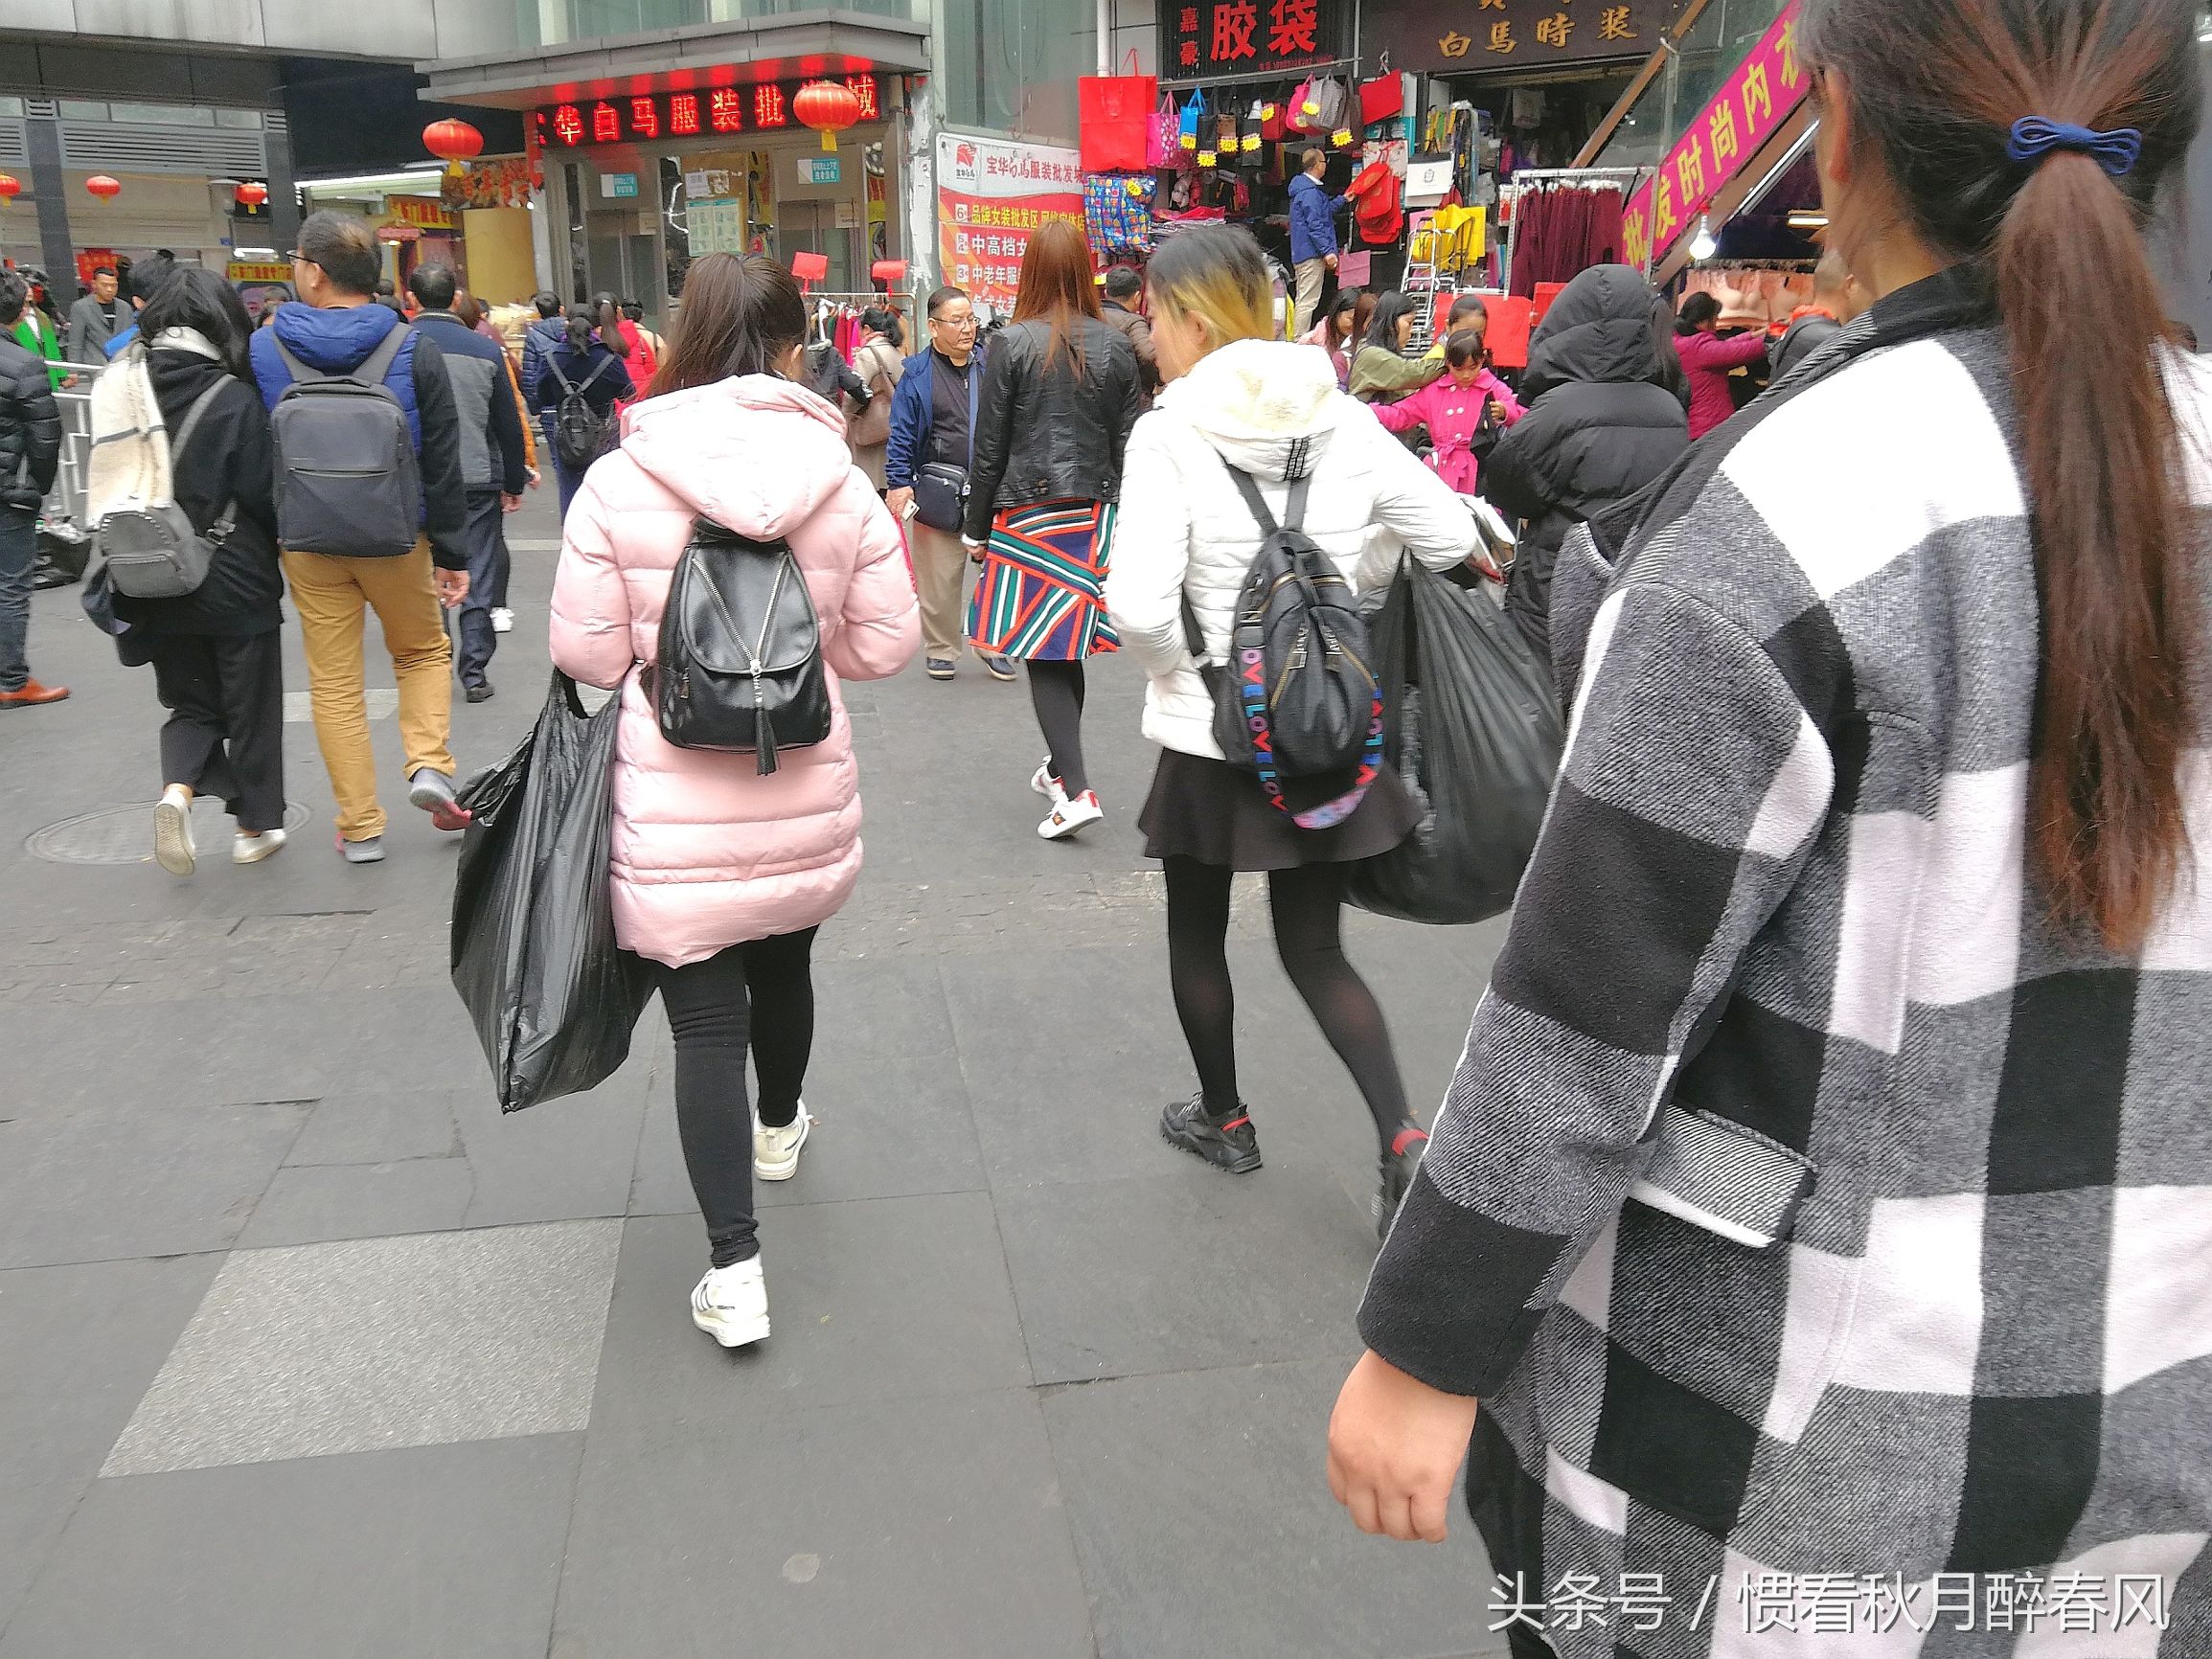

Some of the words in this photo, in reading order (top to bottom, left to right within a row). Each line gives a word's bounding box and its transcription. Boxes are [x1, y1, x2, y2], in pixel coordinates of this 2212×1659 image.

[1179, 7, 1198, 66] 嘉豪
[1210, 0, 1318, 61] 胶袋
[537, 74, 879, 147] 华白马服装批城
[972, 265, 1021, 286] 中老年服
[1245, 704, 1273, 764] LOVE
